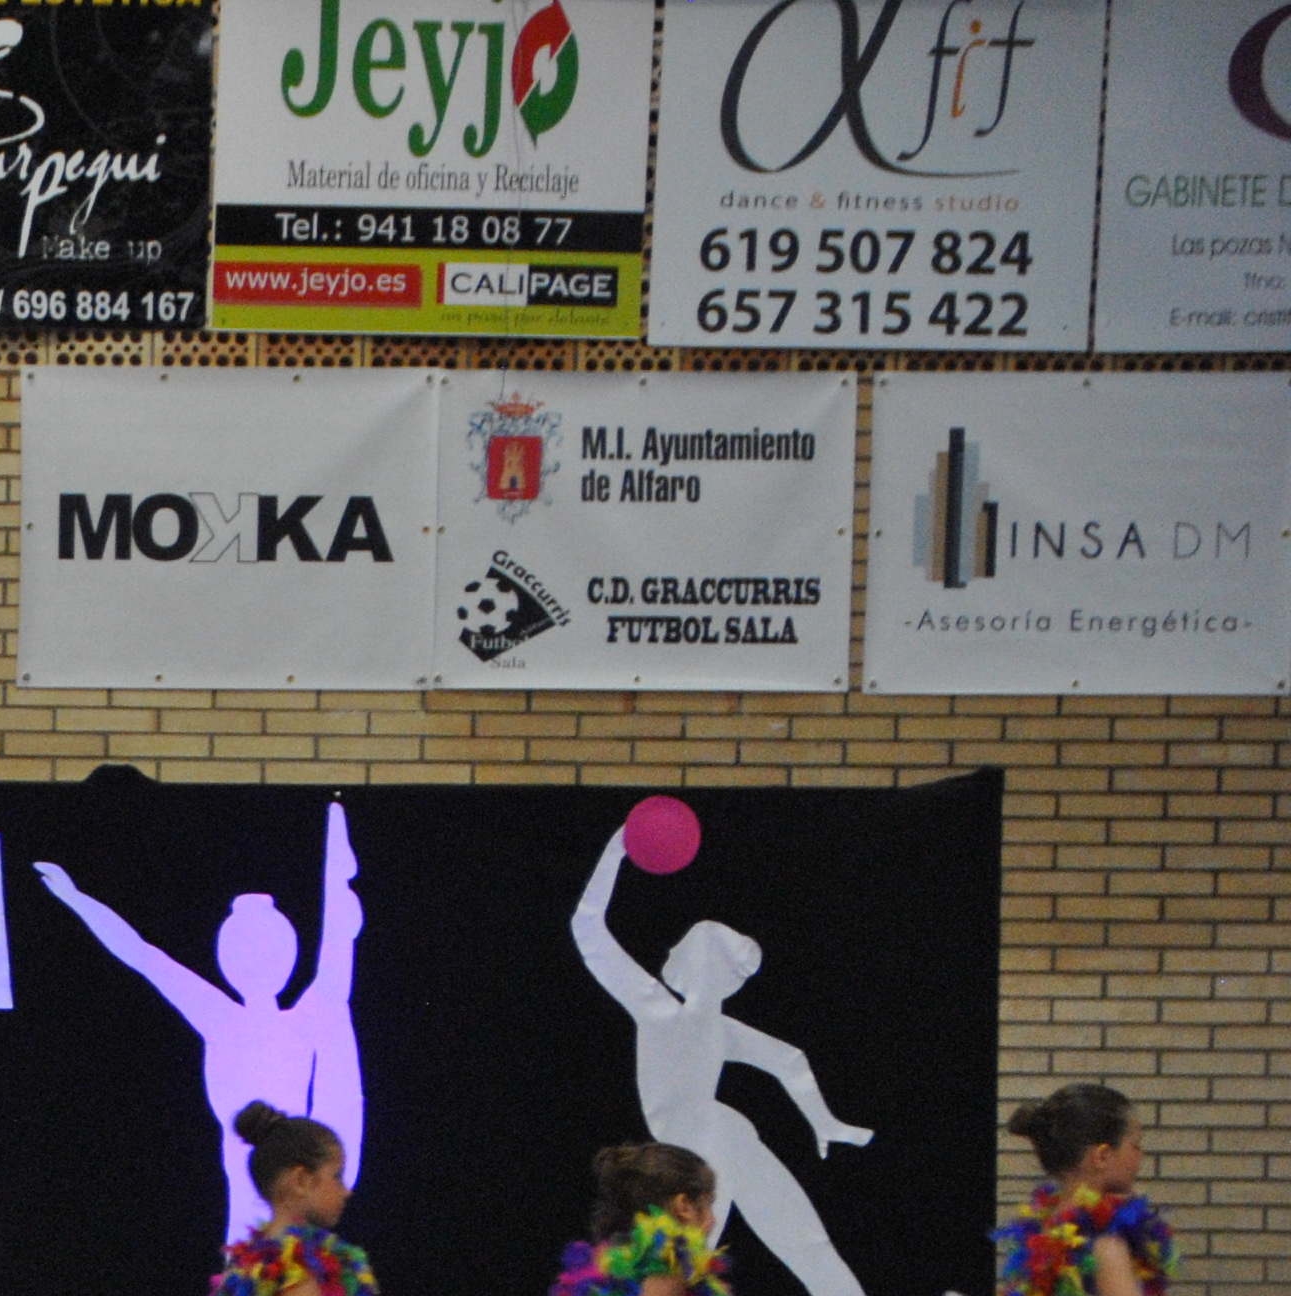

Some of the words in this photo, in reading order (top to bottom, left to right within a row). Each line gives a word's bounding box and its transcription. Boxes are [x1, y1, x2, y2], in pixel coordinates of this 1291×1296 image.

[286, 159, 370, 190] Material
[377, 162, 400, 190] de
[406, 161, 470, 191] oficina
[475, 170, 488, 198] y
[494, 163, 580, 199] Reciclaje
[1125, 173, 1269, 208] GABINETE
[720, 190, 799, 210] dance
[808, 192, 826, 210] &
[837, 190, 923, 211] fitness
[934, 192, 1021, 212] studio
[275, 212, 343, 241] Tel.:
[358, 213, 416, 243] 941
[432, 215, 469, 244] 18
[481, 215, 521, 245] 08
[534, 217, 573, 246] 77
[700, 227, 801, 273] 619
[816, 227, 917, 275] 507
[931, 228, 1034, 276] 824
[225, 267, 407, 296] www.jeyjo.es
[450, 271, 613, 298] CALIPAGE
[12, 289, 67, 321] 696
[75, 290, 131, 322] 884
[142, 291, 195, 322] 167
[697, 287, 798, 334] 657
[813, 289, 913, 336] 315
[928, 291, 1030, 337] 422
[581, 426, 632, 461] M.I.
[641, 426, 816, 466] Ayuntamiento
[581, 468, 610, 502] de
[619, 468, 701, 503] Alfaro
[1010, 520, 1147, 560] INSA
[1172, 520, 1252, 560] DM
[492, 550, 571, 627] Graccurris
[586, 576, 635, 604] C.D.
[640, 576, 821, 606] GRACCURRIS
[606, 615, 718, 644] FUTBOL
[723, 616, 799, 645] SALA
